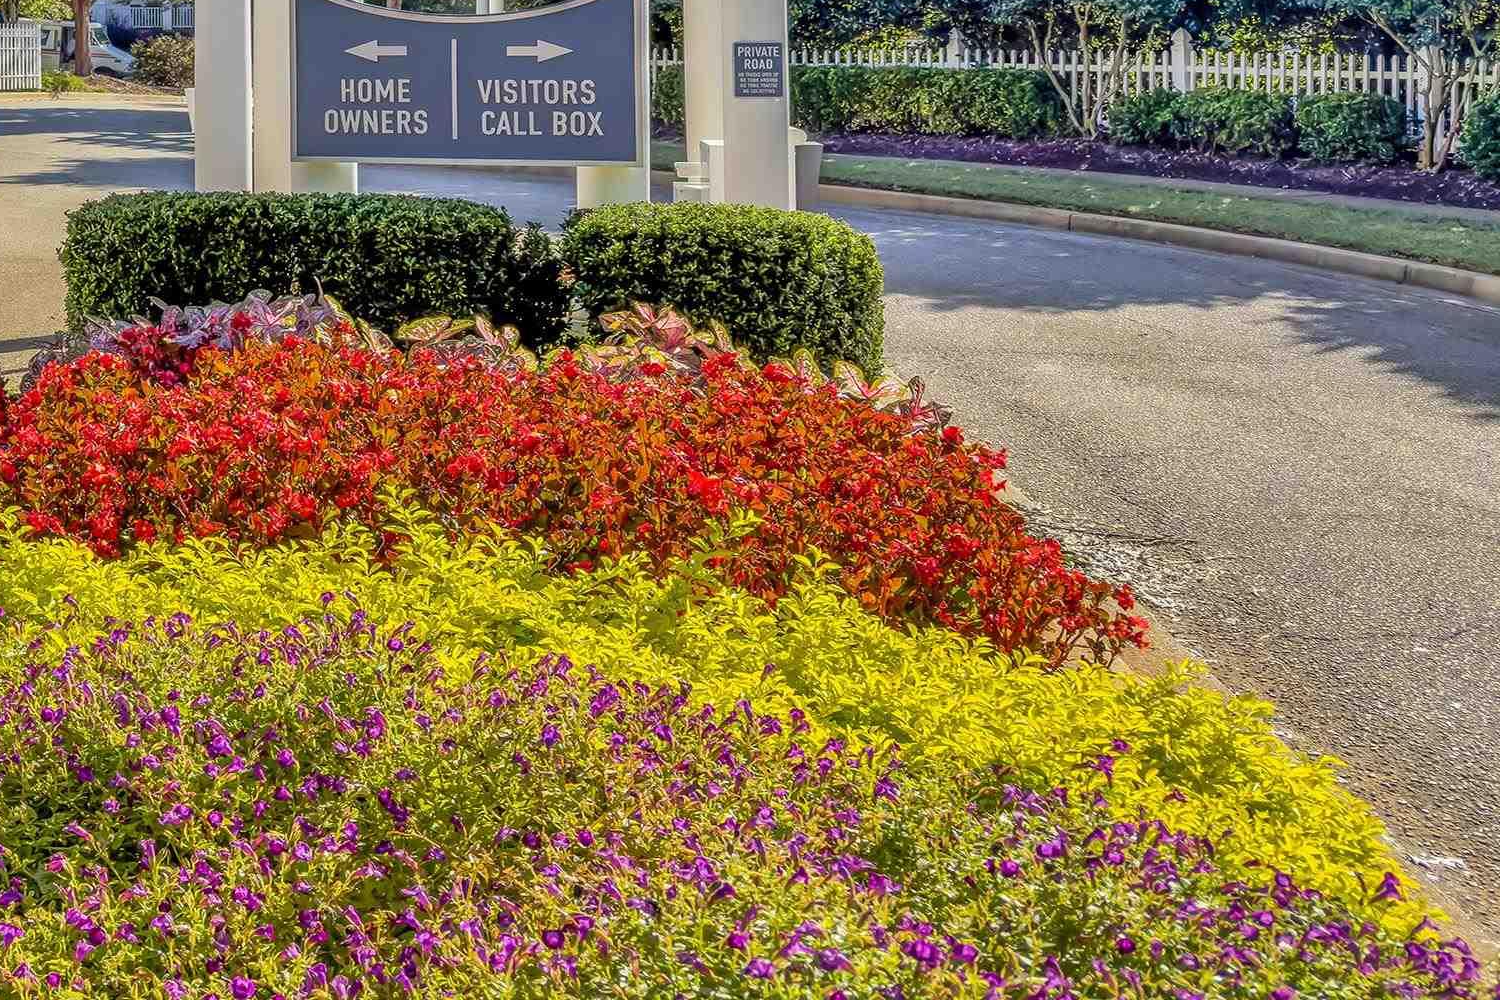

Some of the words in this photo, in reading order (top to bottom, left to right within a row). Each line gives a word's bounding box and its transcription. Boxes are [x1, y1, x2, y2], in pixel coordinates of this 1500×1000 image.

[737, 46, 780, 57] PRIVATE
[744, 58, 773, 70] ROAD
[340, 78, 411, 103] HOME
[477, 79, 597, 104] VISITORS
[324, 109, 429, 135] OWNERS
[481, 110, 542, 136] CALL
[552, 111, 605, 136] BOX
